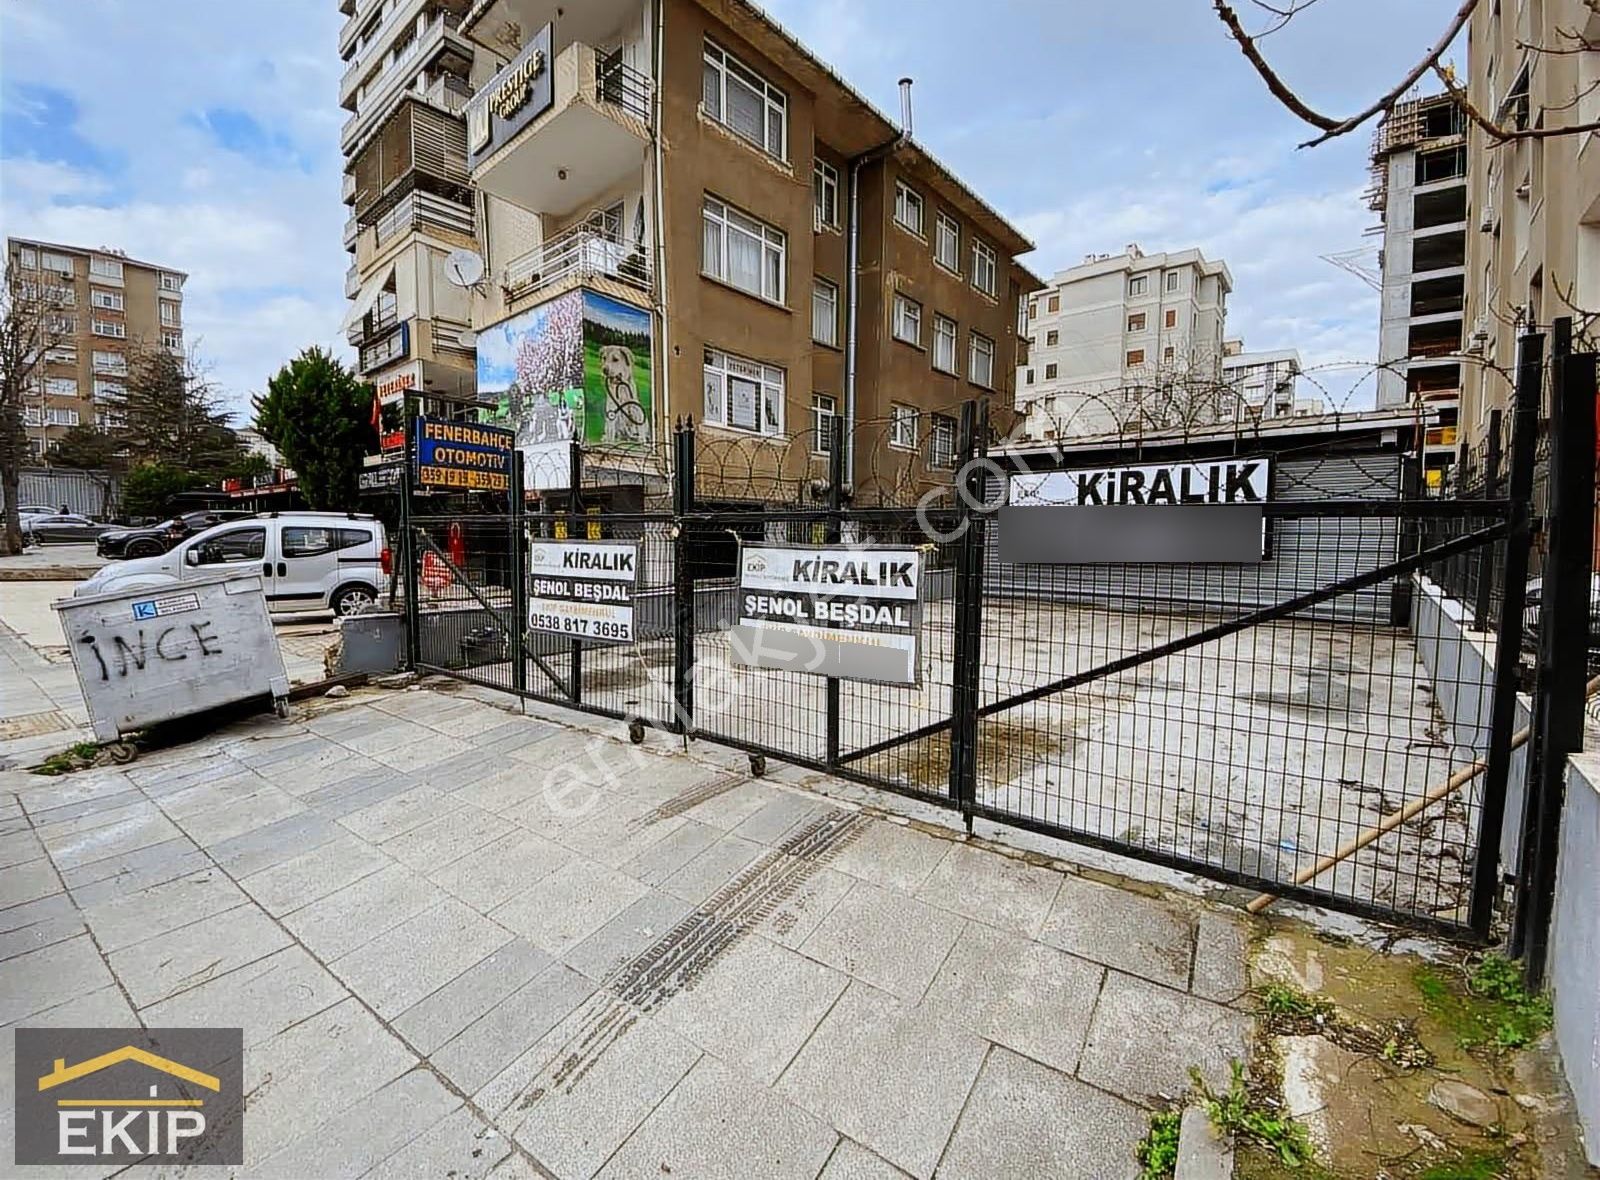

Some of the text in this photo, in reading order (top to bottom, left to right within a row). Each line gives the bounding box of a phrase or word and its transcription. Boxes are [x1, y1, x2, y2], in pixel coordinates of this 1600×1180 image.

[425, 423, 513, 452] FENERBAHÇE
[563, 548, 634, 572] KİRALIK
[792, 555, 914, 587] KİRALIK
[533, 580, 630, 602] ŞENOL BEŞDAL
[745, 595, 910, 627] ŞENOL BEŞDAL
[531, 613, 629, 639] 0538 817 3695
